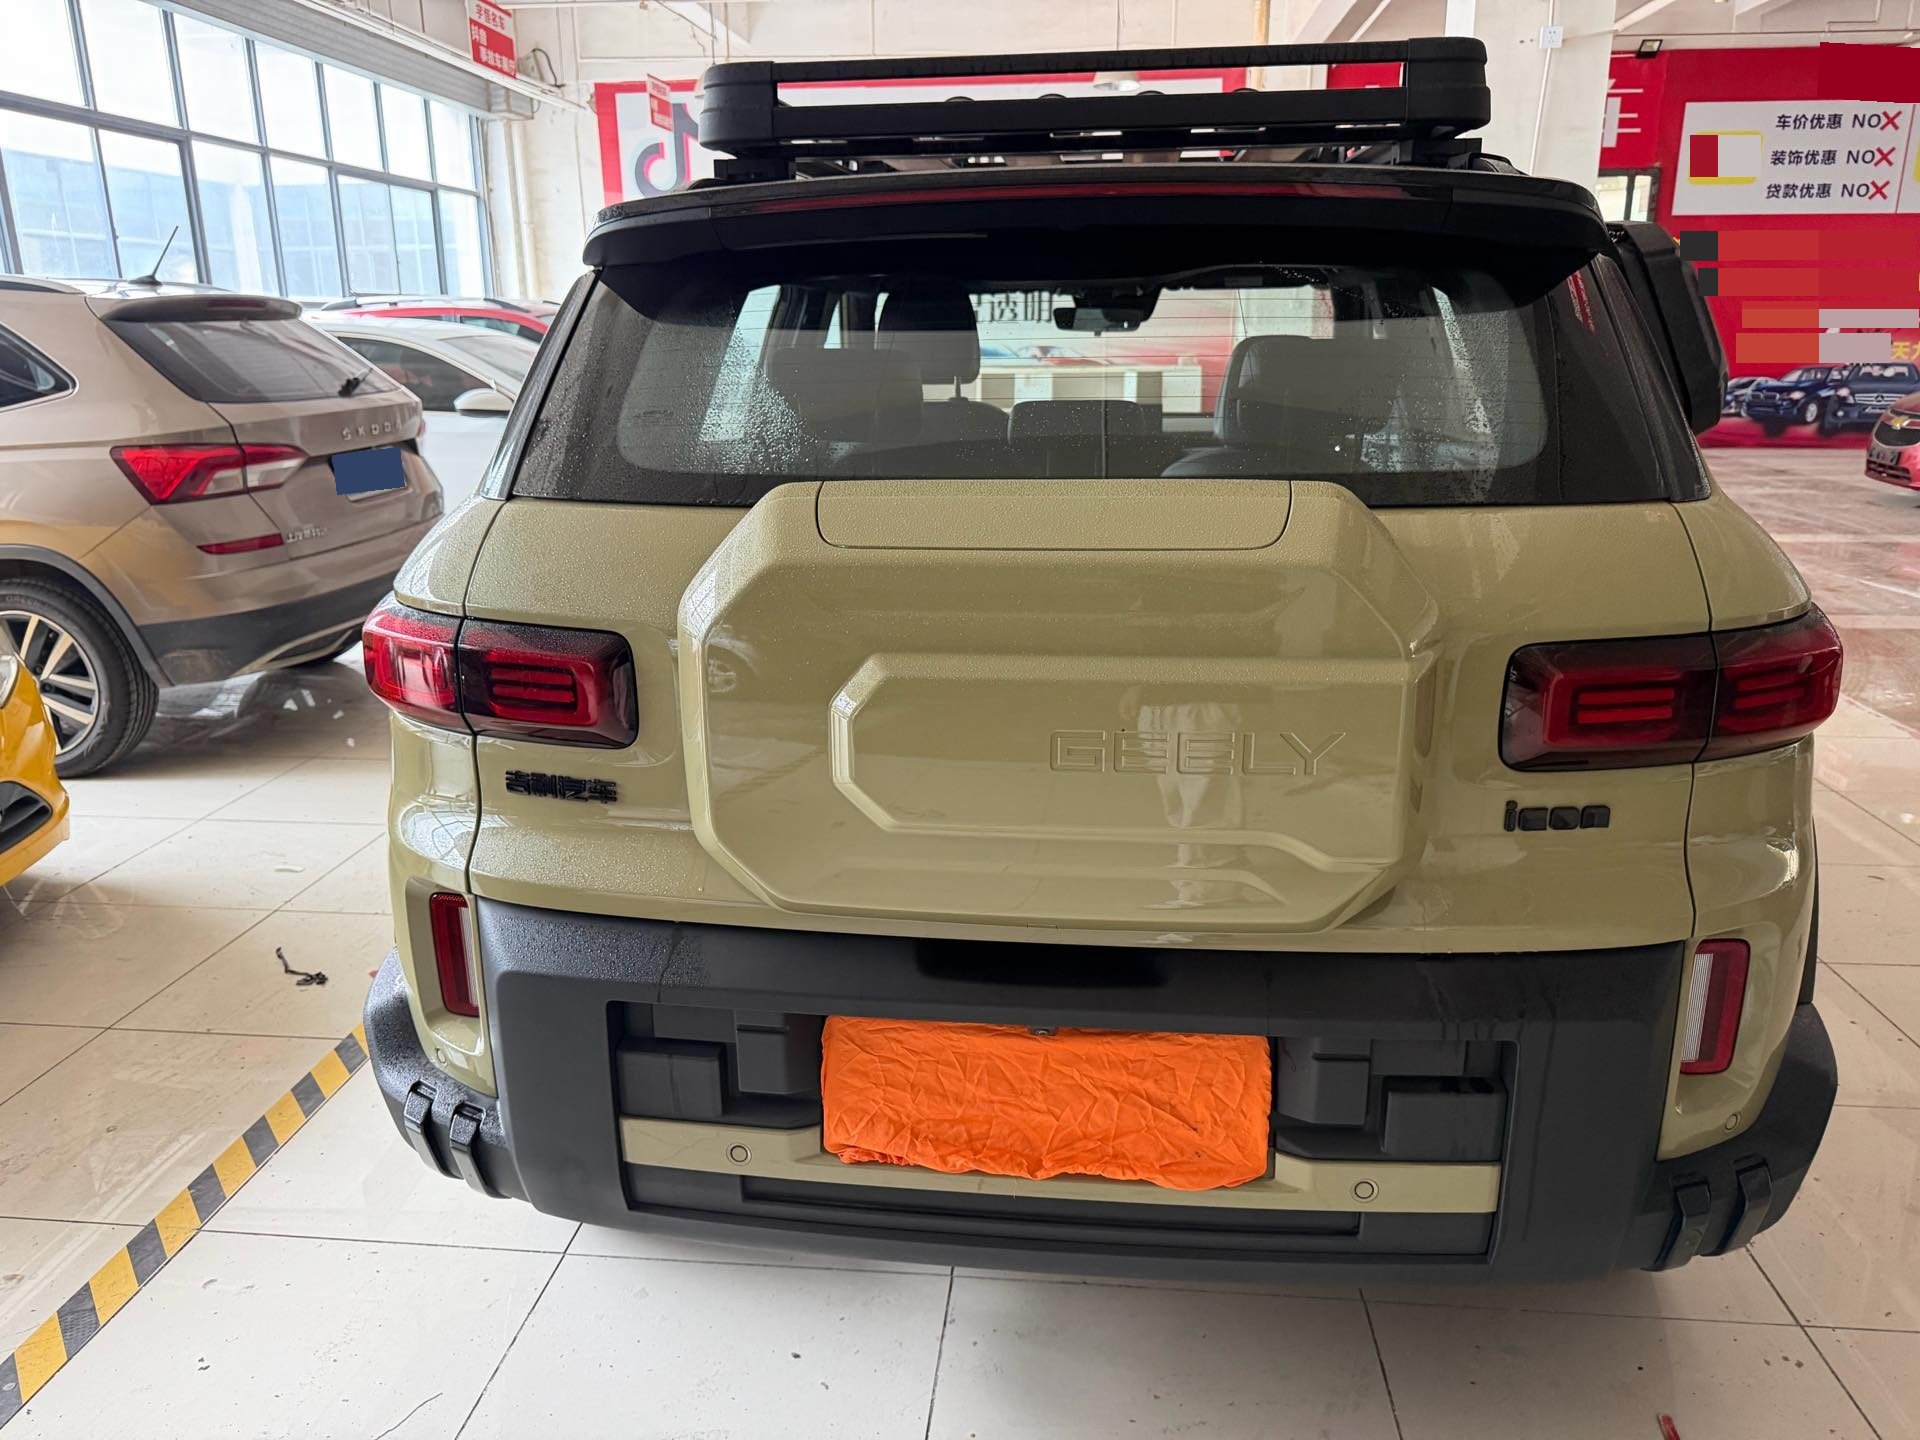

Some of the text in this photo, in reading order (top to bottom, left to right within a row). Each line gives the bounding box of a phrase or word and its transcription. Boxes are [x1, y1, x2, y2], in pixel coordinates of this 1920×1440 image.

[1776, 113, 1843, 130] 车价优惠
[1770, 150, 1837, 166] 装饰优惠
[1766, 183, 1832, 199] 贷款优惠
[1050, 730, 1346, 775] GEELY
[505, 770, 617, 804] 吉利汽车
